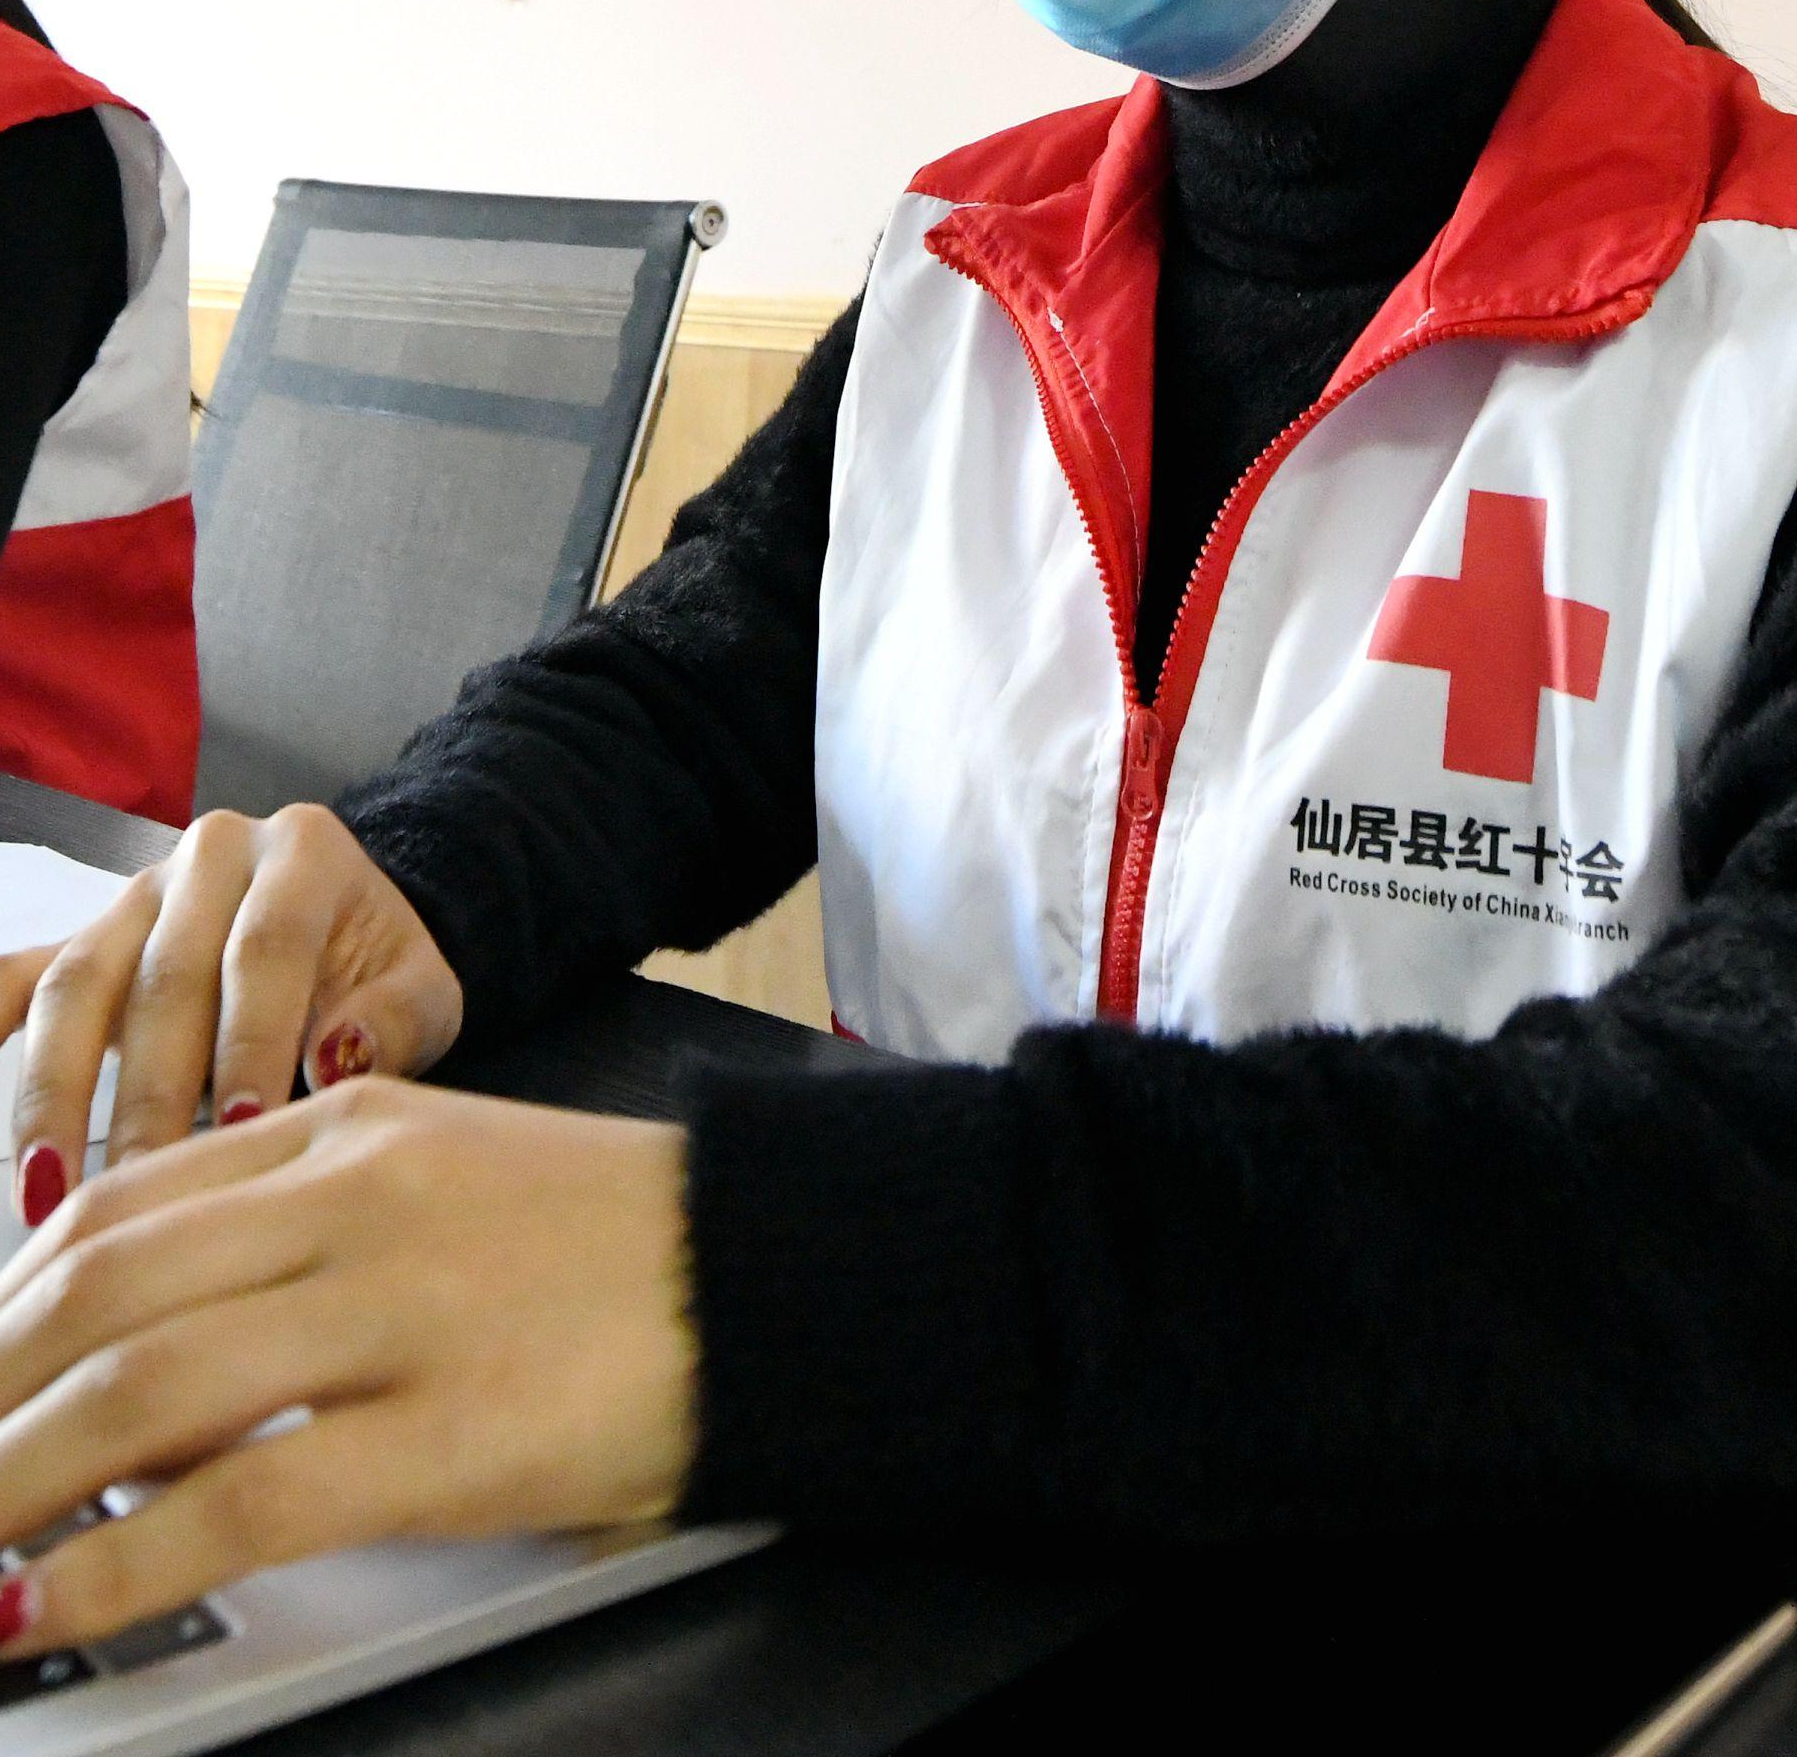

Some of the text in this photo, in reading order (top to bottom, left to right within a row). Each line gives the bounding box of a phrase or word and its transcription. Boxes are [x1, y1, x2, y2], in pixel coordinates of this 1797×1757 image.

[1289, 866, 1323, 890] Red
[1327, 872, 1382, 899] Cross
[1386, 880, 1458, 913] Society
[1462, 893, 1482, 912] of
[1486, 894, 1541, 923] China
[1576, 920, 1630, 942] ranch
